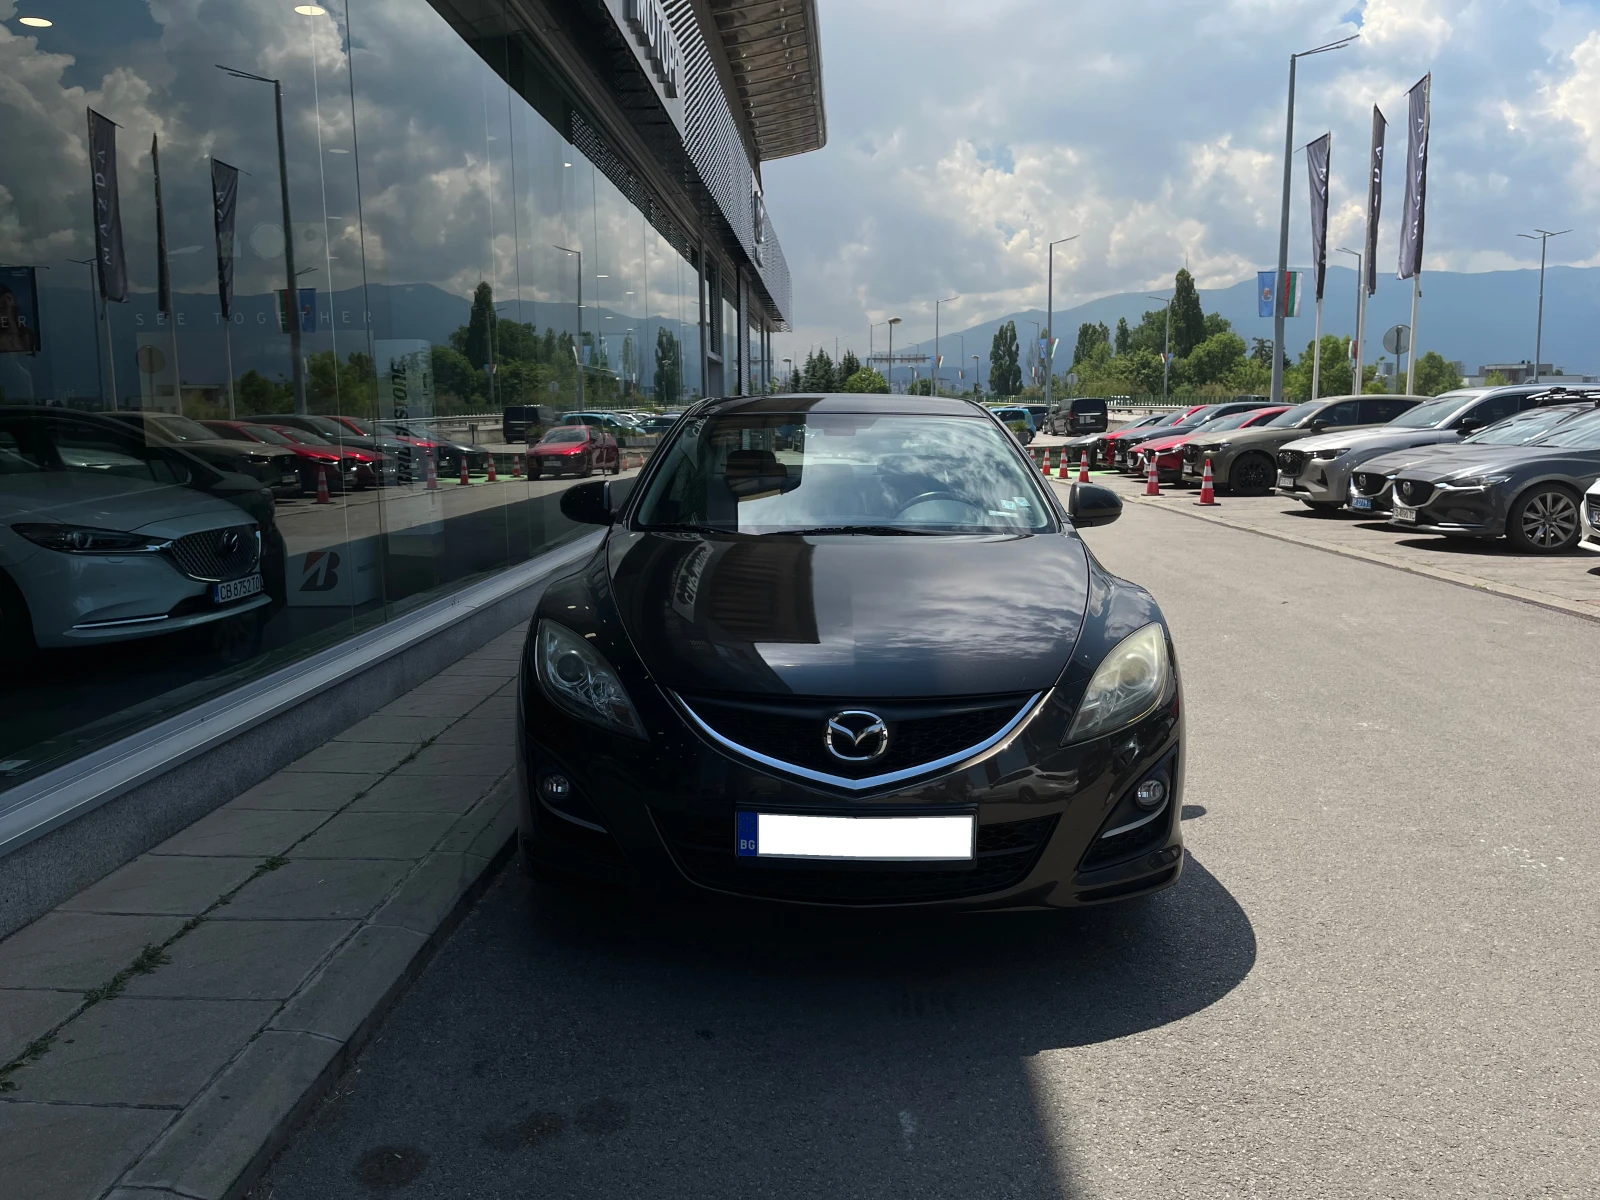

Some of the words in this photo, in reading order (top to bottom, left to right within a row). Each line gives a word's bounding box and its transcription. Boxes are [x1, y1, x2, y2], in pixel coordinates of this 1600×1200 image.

[135, 312, 187, 326] SEE
[213, 311, 373, 326] TOGETHER
[233, 578, 251, 597] 8752
[740, 839, 756, 850] BG
